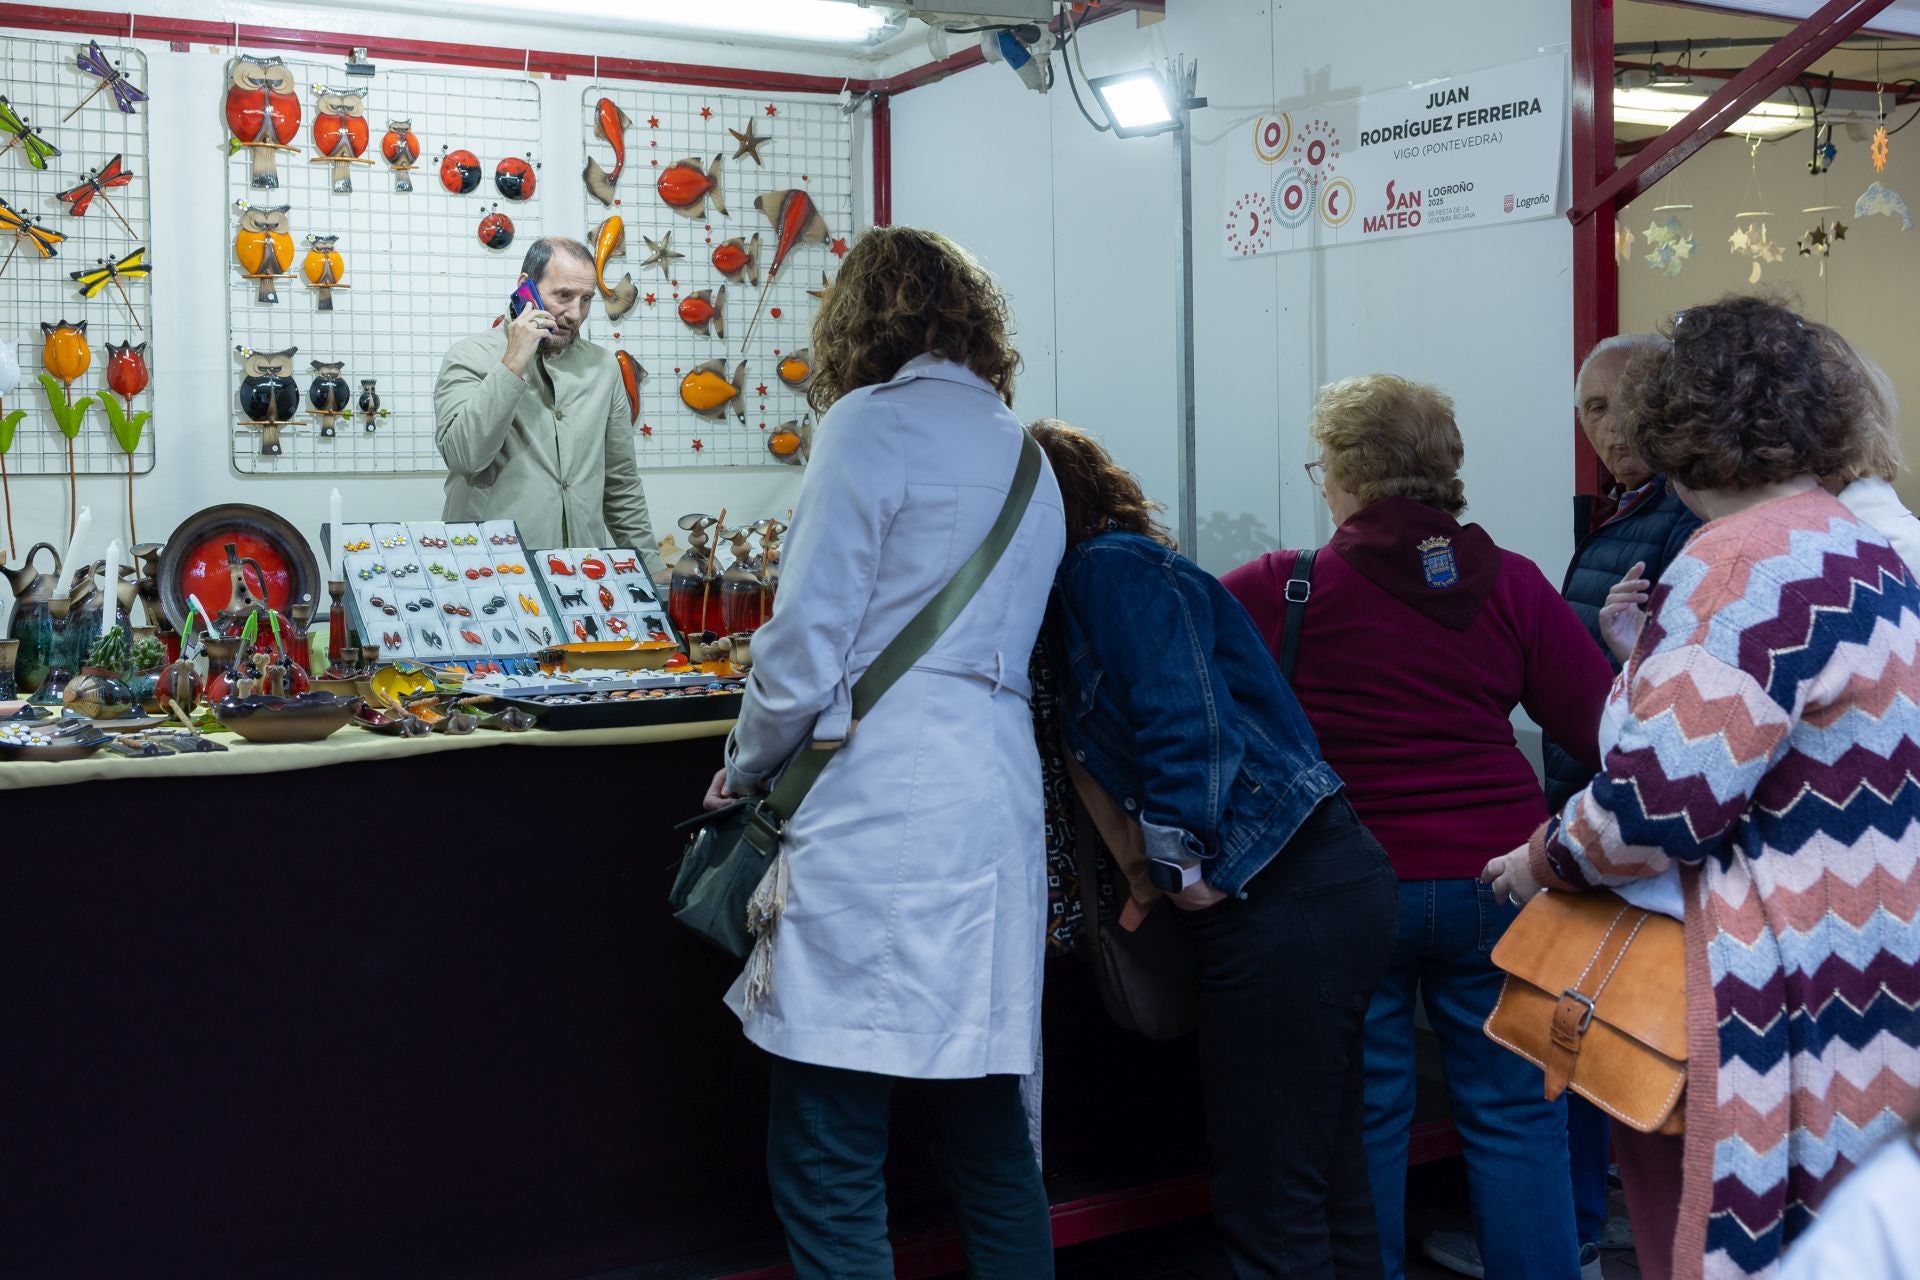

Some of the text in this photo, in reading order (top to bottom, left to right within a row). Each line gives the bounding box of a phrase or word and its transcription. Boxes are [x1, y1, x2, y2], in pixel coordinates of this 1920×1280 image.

[1425, 86, 1470, 110] JUAN
[1360, 98, 1542, 147] RODRÍGUEZ FERREIRA
[1393, 132, 1503, 160] VIGO (PONTEVEDRA)
[1386, 179, 1422, 211] SAN
[1428, 182, 1474, 198] LOGROÑO
[1428, 197, 1444, 207] 2025
[1515, 193, 1550, 209] Logroño
[1363, 209, 1422, 233] MATEO
